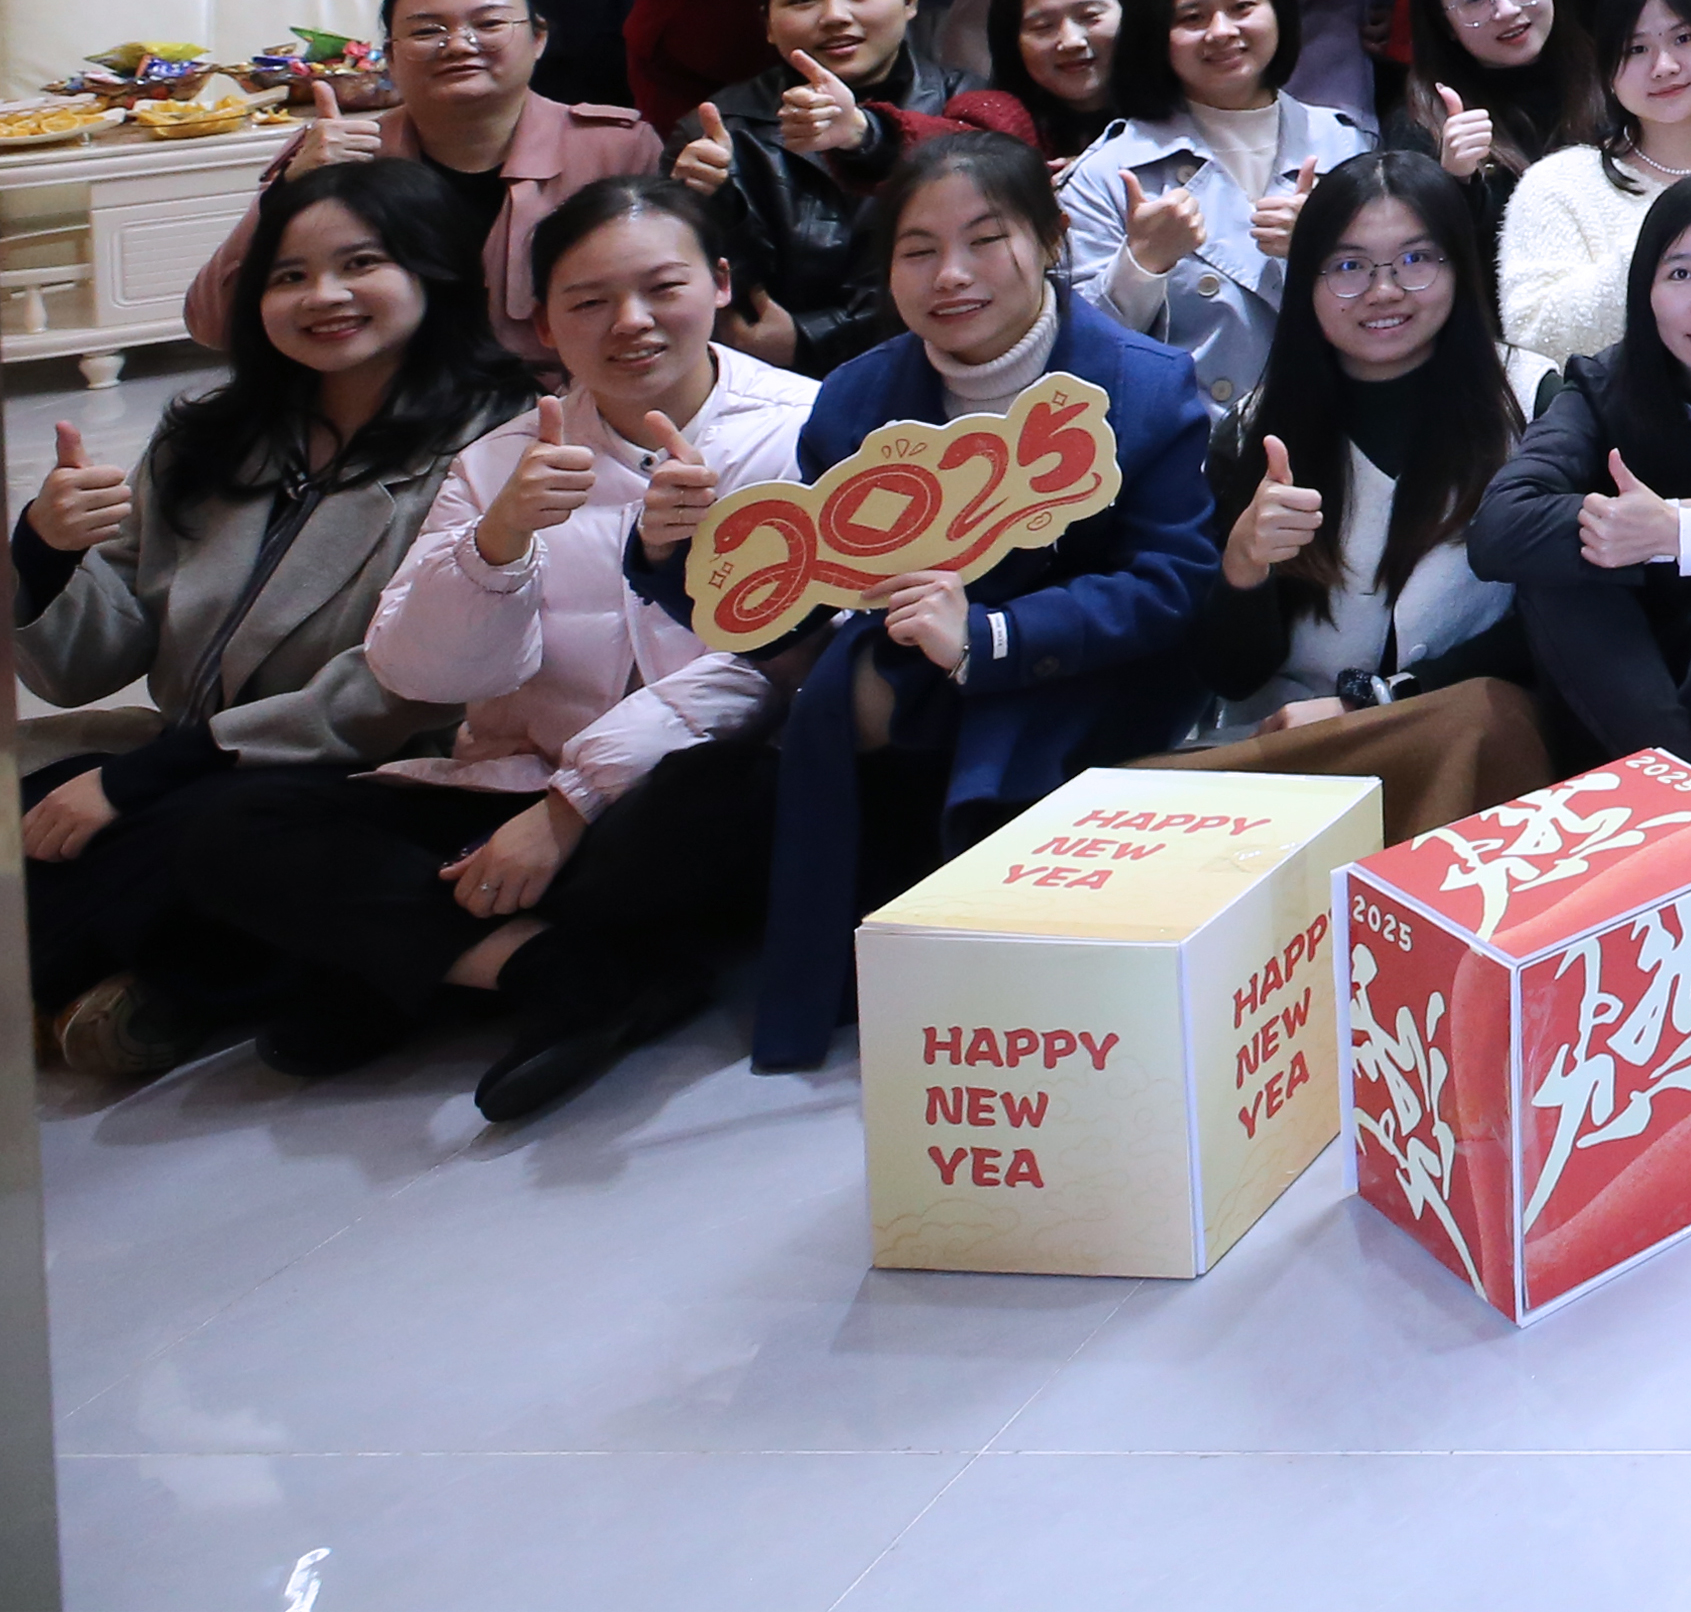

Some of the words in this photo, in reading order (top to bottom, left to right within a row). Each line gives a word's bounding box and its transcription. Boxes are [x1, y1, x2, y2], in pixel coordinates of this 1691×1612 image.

[711, 400, 1103, 634] 2025
[1075, 809, 1272, 837] HAPPY
[1031, 835, 1167, 862] NEW
[1002, 863, 1115, 893] YEA
[1352, 894, 1414, 952] 2025
[1232, 907, 1332, 1029] HAPP
[923, 1026, 1120, 1071] HAPPY
[1236, 986, 1311, 1089] NEW
[925, 1085, 1048, 1129] NEW
[1238, 1050, 1310, 1139] YEA
[927, 1146, 1046, 1189] YEA
